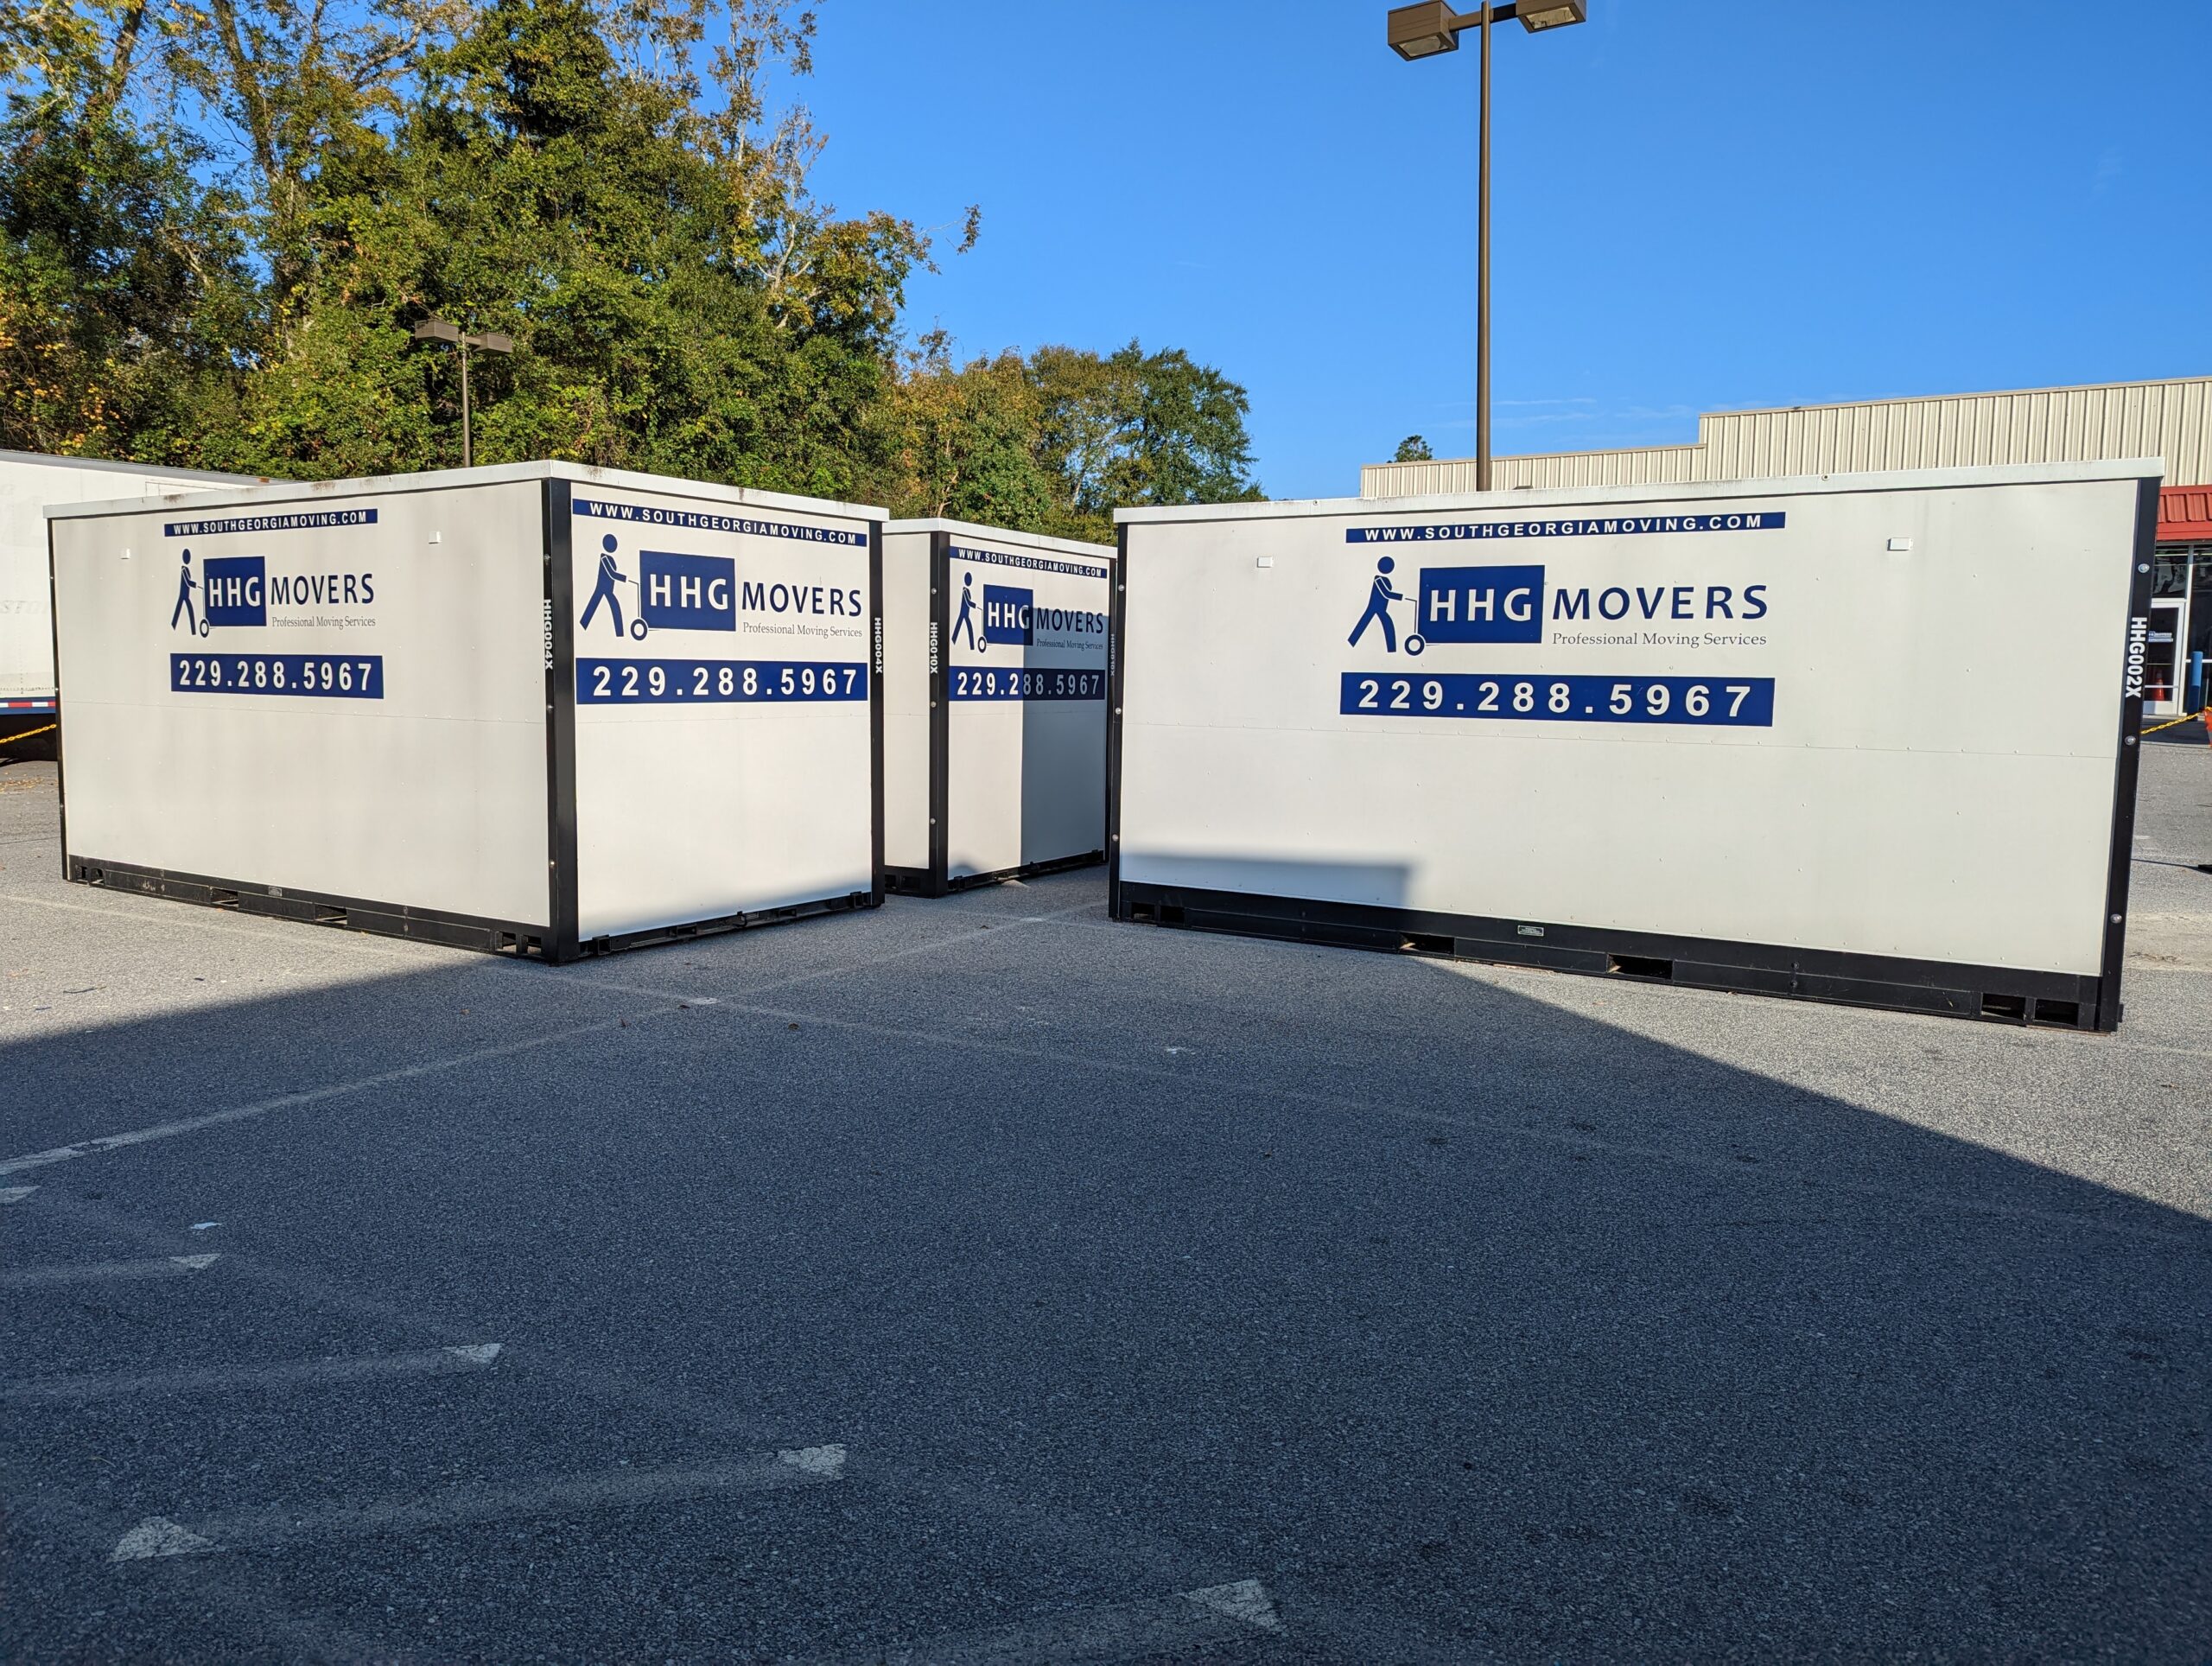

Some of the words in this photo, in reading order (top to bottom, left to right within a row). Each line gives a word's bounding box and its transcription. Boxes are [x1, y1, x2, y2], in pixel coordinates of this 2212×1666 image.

[174, 510, 367, 536] WWW.SOUTHGEORGIAMOVING.COM
[590, 502, 856, 544] WWW.SOUTHGEORGIAMOVING.COM
[1364, 513, 1763, 541] WWW.SOUTHGEORGIAMOVING.COM
[958, 549, 1102, 577] WWW.SOUTHGEORGIAMOVING.COM
[208, 576, 261, 607] HHG
[270, 573, 375, 606] MOVERS
[650, 574, 728, 610] HHG
[742, 582, 861, 617] MOVERS
[1429, 588, 1533, 622] HHG
[1552, 585, 1768, 620] MOVERS
[272, 616, 315, 628] Professional
[316, 616, 343, 630] Moving
[345, 616, 376, 628] Services
[742, 621, 795, 636] Professional
[797, 623, 829, 639] Moving
[830, 625, 862, 638] Services
[988, 601, 1030, 630] HHG
[1036, 607, 1103, 634] MOVERS
[543, 599, 554, 670] HHG004X
[874, 617, 883, 674] HHG004X
[930, 621, 938, 675] HHG010X
[1036, 639, 1065, 649] Professional
[1066, 640, 1084, 651] Moving
[1085, 641, 1103, 650] Services
[1552, 633, 1638, 645] Professional
[1642, 632, 1700, 649] Moving
[1702, 633, 1767, 645] Services
[2125, 617, 2148, 698] HHG002X
[179, 660, 372, 691] 229.288.5967
[593, 666, 857, 696] 229.288.5967
[957, 671, 1099, 696] 229.288.5967
[1358, 679, 1751, 718] 229.288.5967
